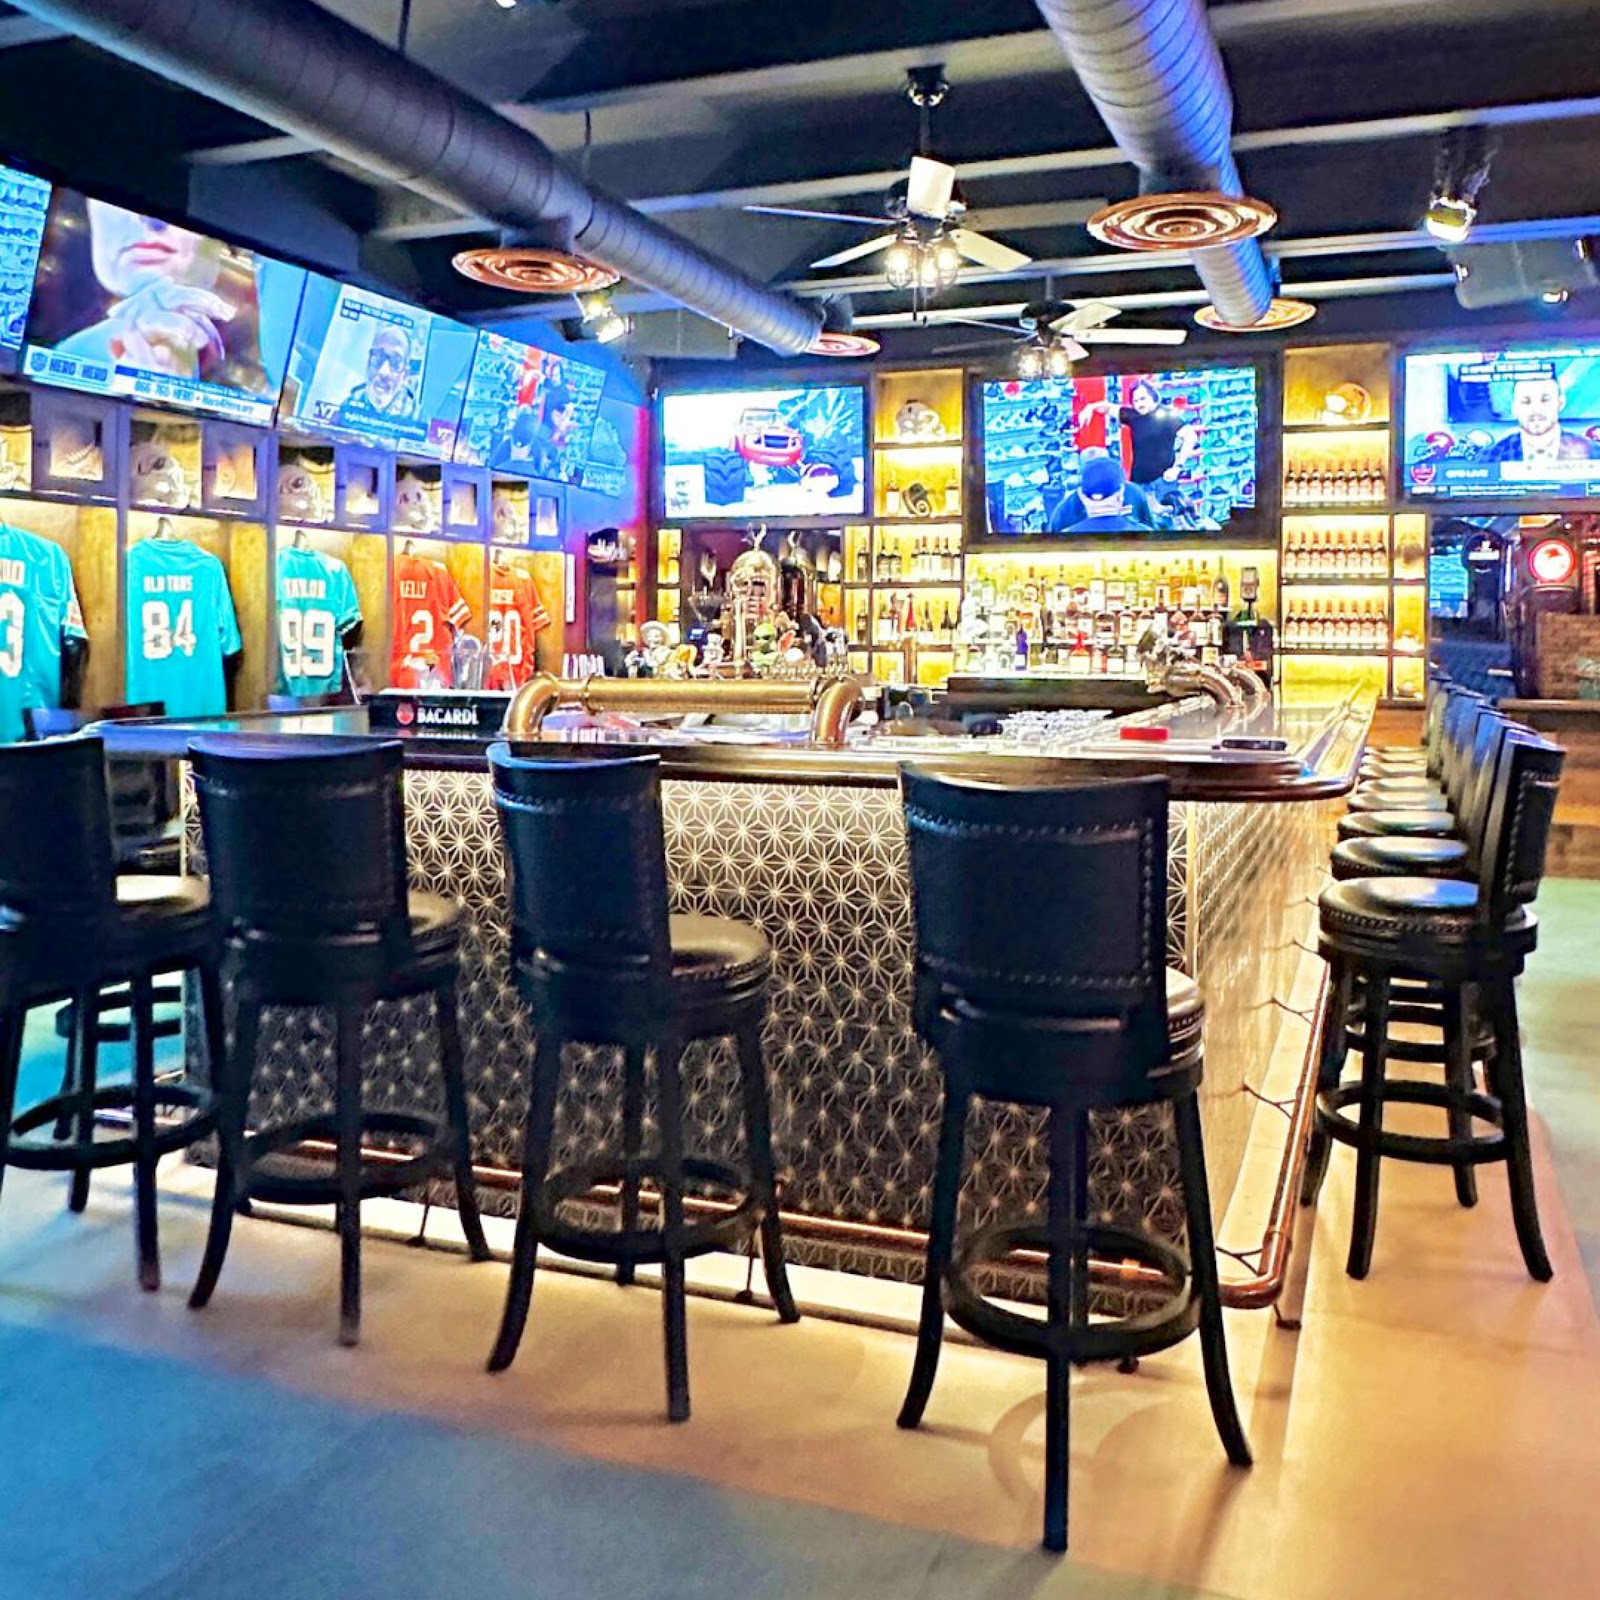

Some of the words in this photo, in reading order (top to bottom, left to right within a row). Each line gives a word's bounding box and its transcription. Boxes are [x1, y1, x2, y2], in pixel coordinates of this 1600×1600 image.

[400, 580, 427, 599] KELLY
[142, 599, 198, 660] 84
[280, 610, 336, 677] 99
[417, 704, 479, 725] BACARDÍ
